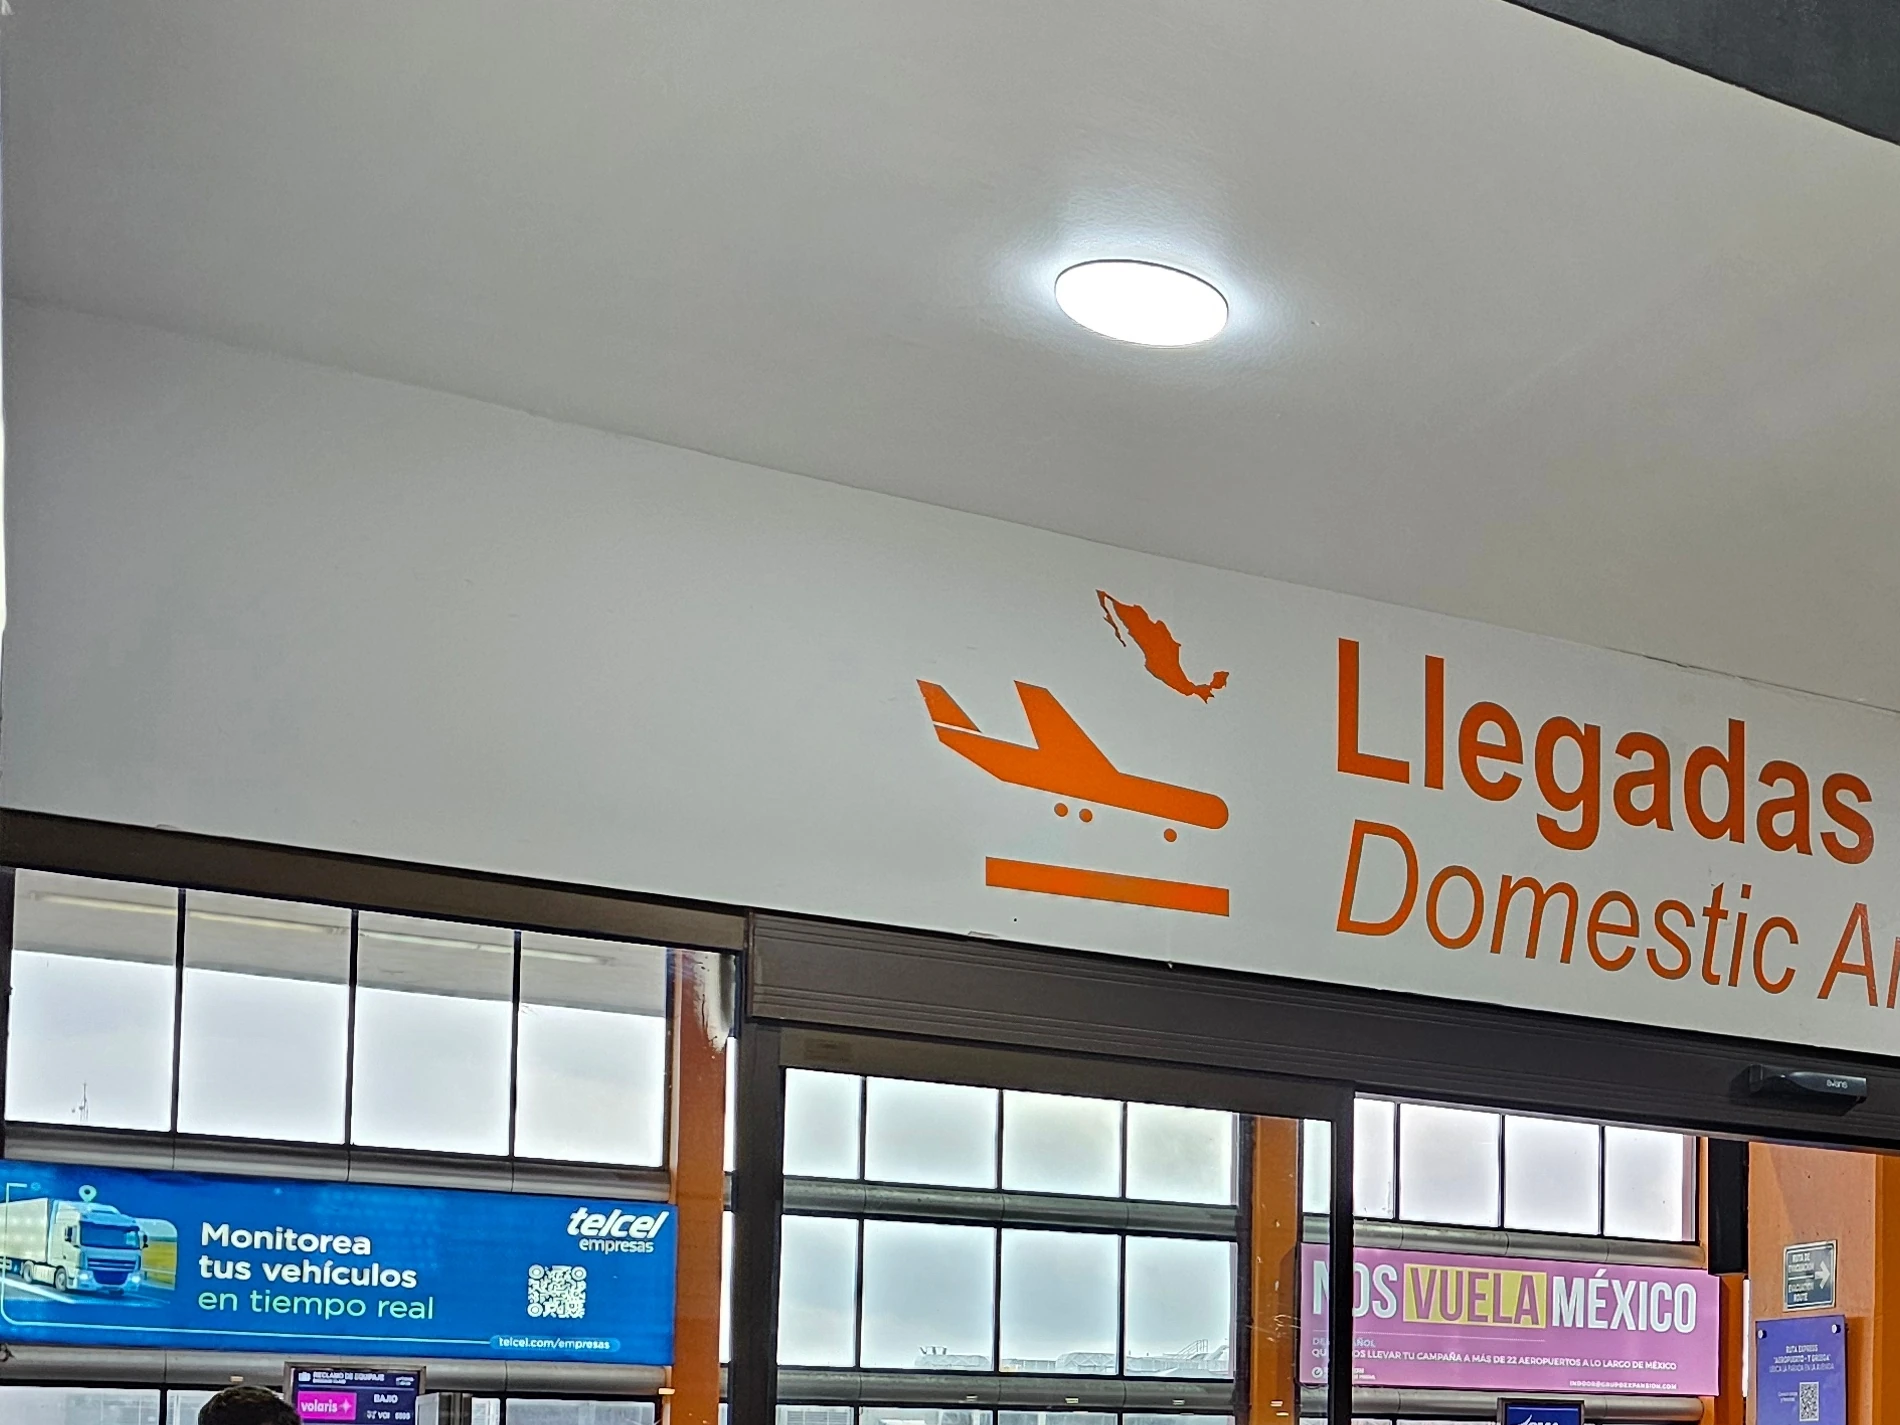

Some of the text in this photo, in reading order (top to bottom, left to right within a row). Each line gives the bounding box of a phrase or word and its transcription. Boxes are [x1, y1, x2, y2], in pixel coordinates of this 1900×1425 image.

[1337, 638, 1874, 866] Llegadas
[1337, 820, 1799, 994] Domestic
[201, 1222, 371, 1255] Monitorea
[567, 1207, 670, 1239] telcel
[579, 1238, 654, 1255] empresas
[199, 1255, 418, 1289] tus vehículos
[198, 1289, 433, 1320] en tiempo real
[1410, 1268, 1540, 1325] VUELA
[1551, 1268, 1697, 1334] MÉXICO
[499, 1337, 610, 1350] telcel.com/empresas
[1367, 1350, 1402, 1359] LLEVAR
[1403, 1351, 1415, 1360] TU
[1417, 1352, 1462, 1362] CAMPAÑA
[1463, 1354, 1471, 1362] A
[1472, 1353, 1491, 1363] MÁS
[1493, 1355, 1506, 1364] DE
[1506, 1356, 1517, 1364] 22
[1518, 1357, 1581, 1367] AEROPUERTOS
[1582, 1358, 1589, 1367] A
[1590, 1359, 1602, 1367] LO
[1602, 1359, 1631, 1369] LARGO
[1632, 1361, 1643, 1369] DE
[1645, 1360, 1677, 1371] MÉXICO
[301, 1399, 338, 1413] volaris
